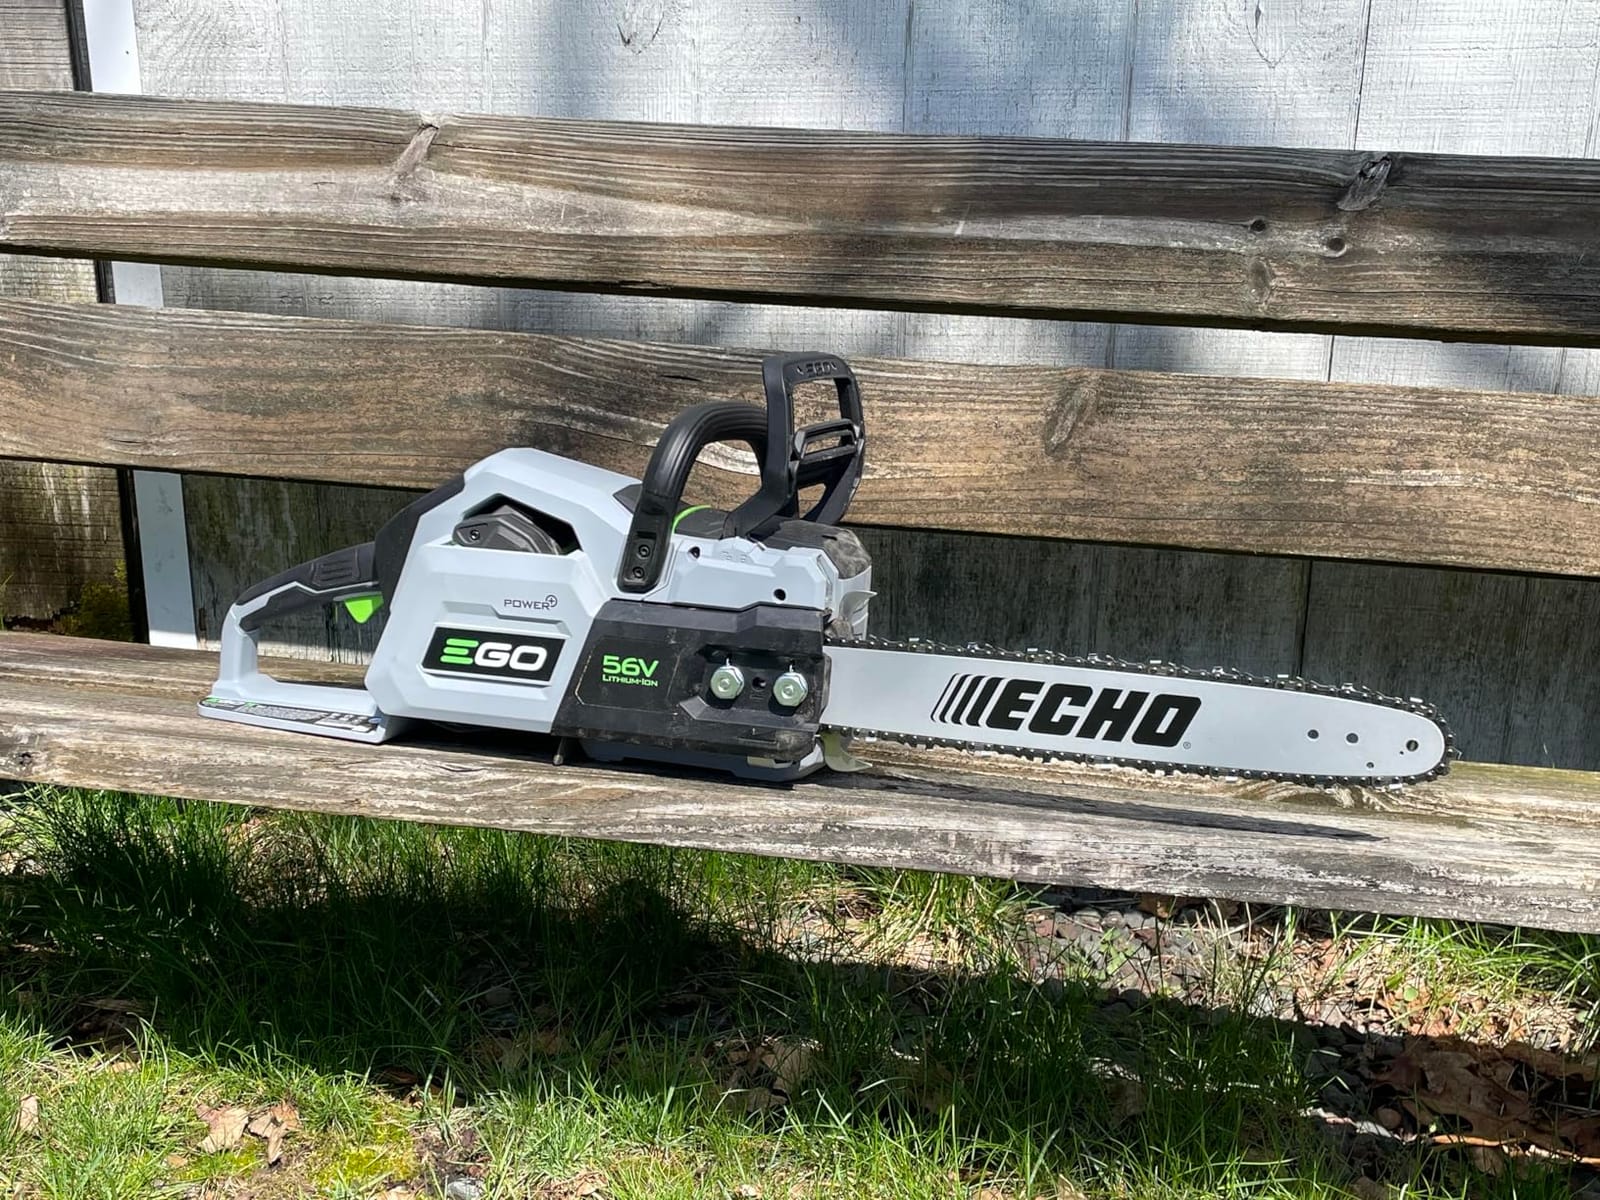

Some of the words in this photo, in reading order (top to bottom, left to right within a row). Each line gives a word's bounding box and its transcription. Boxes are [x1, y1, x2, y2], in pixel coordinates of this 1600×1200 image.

[440, 638, 547, 671] EGO
[602, 655, 659, 678] 56V
[986, 678, 1202, 747] ECHO
